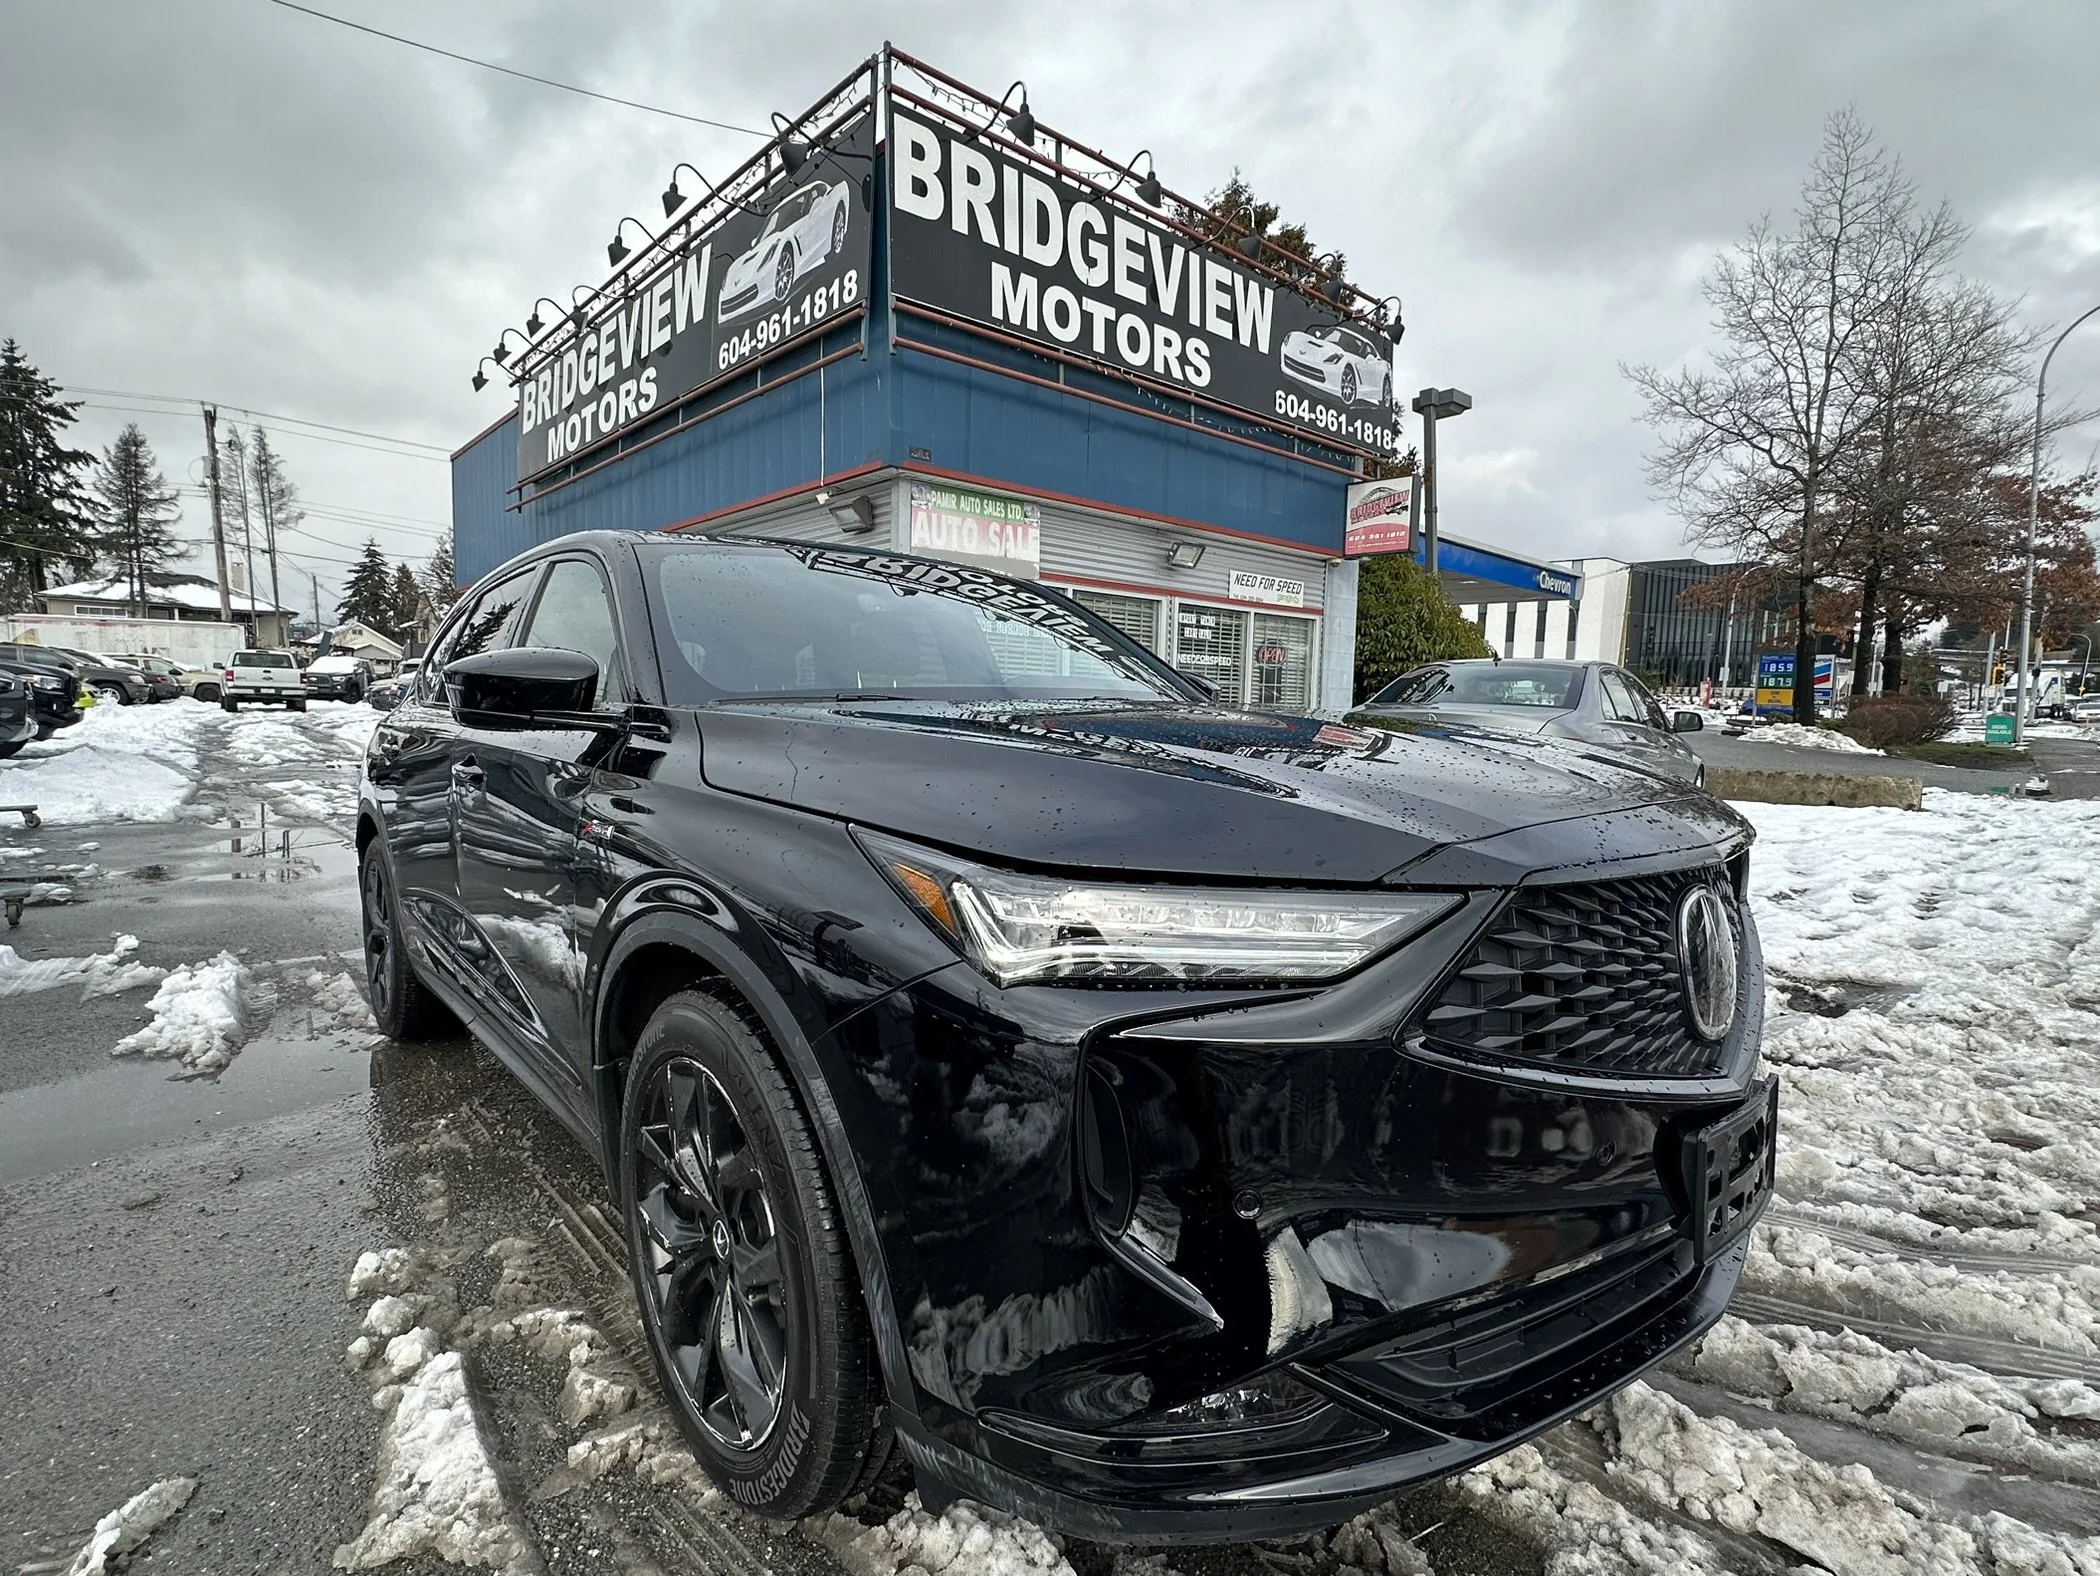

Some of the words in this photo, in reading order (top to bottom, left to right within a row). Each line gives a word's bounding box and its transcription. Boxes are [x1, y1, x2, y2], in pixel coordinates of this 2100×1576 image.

[893, 112, 1274, 356] BRIDGEVIEW
[521, 242, 714, 435] BRIDGEVIEW
[718, 269, 859, 371] 604-961-1818
[991, 261, 1212, 388] MOTORS
[546, 366, 659, 463] MOTORS
[1275, 389, 1393, 450] 604-961-1818
[914, 510, 979, 554] AUTO
[988, 521, 1040, 561] SALE
[931, 490, 957, 510] PAMIR
[960, 495, 980, 515] AUTO
[983, 498, 1005, 518] SALES
[1007, 503, 1024, 520] LTD.
[1233, 573, 1258, 588] NEED
[1258, 577, 1276, 591] FOR
[1276, 580, 1303, 595] SPEED
[1539, 570, 1571, 595] Chevron
[1260, 647, 1285, 662] OPEN
[728, 1398, 811, 1506] BRIDGESTONE
